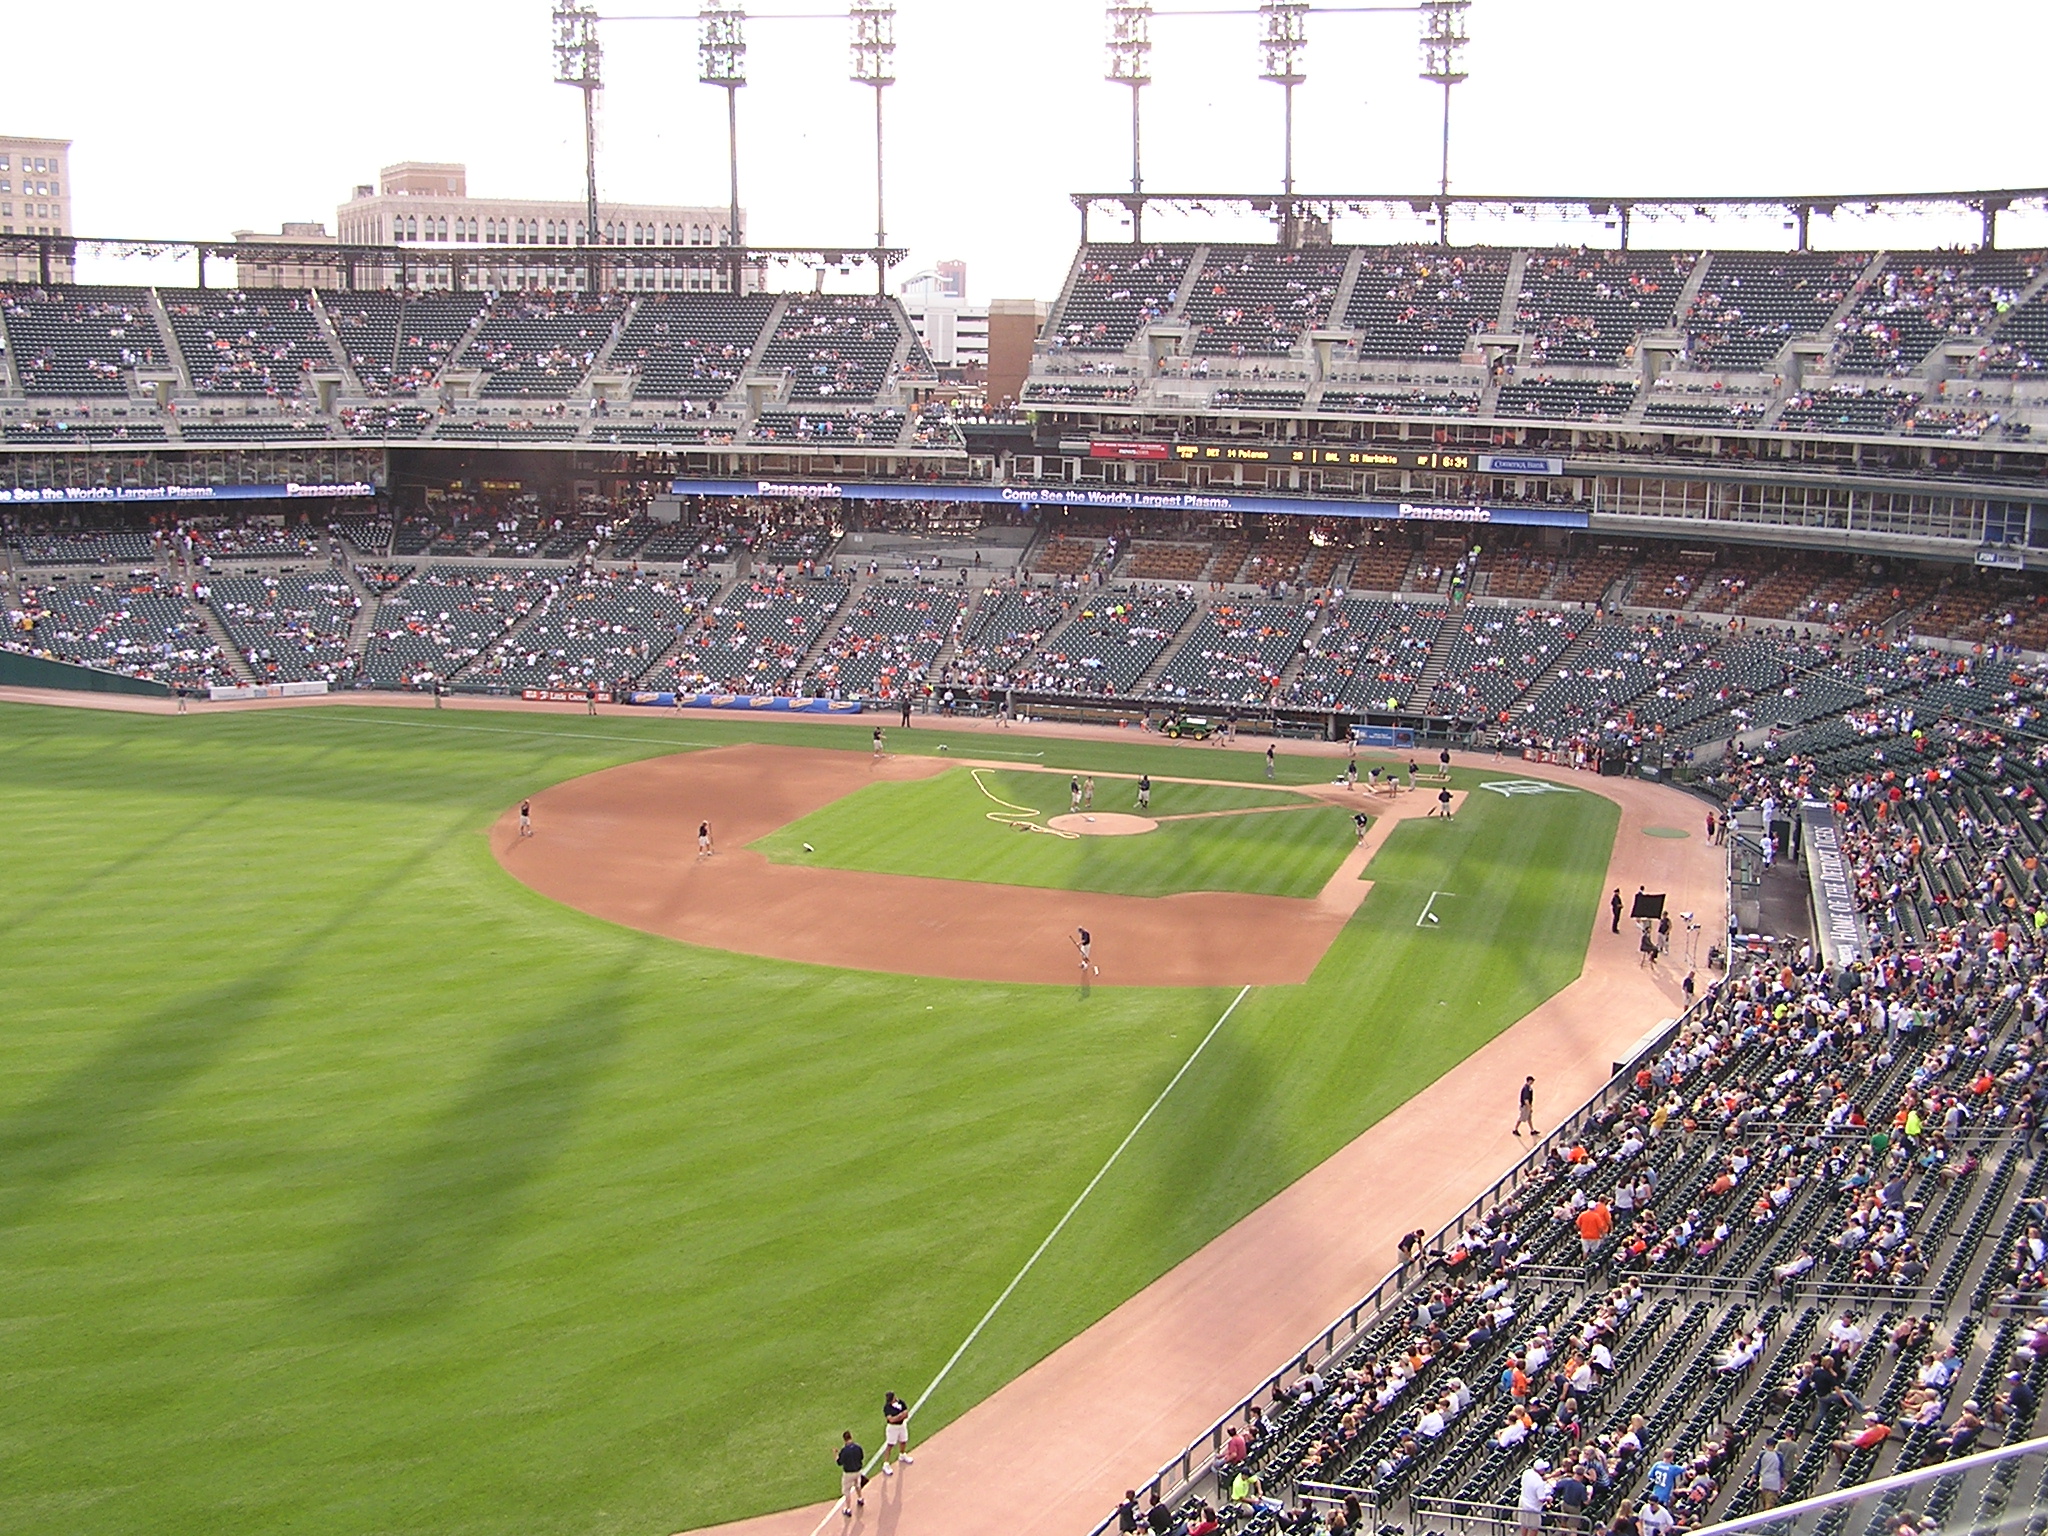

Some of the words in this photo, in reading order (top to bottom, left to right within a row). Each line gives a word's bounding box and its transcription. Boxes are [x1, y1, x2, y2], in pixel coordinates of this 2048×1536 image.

[1442, 455, 1468, 469] 6:34
[1527, 461, 1545, 470] Bank
[13, 488, 40, 500] See
[42, 487, 64, 499] the
[65, 487, 114, 499] World's
[117, 486, 166, 500] Largest
[167, 484, 217, 497] Plasma.
[286, 481, 371, 497] Panasonic
[757, 481, 842, 497] Panasonic
[1001, 487, 1038, 500] Come
[1040, 488, 1063, 501] See
[1065, 490, 1086, 502] the
[1087, 491, 1132, 505] World's
[1134, 492, 1182, 507] Largest
[1184, 494, 1232, 509] Plasma.
[1399, 503, 1491, 523] Panasonic
[549, 692, 567, 701] Little
[1814, 827, 1837, 849] TIGERS
[1818, 850, 1845, 881] DETROIT
[1824, 882, 1849, 899] THE
[1827, 899, 1851, 913] OF
[1830, 912, 1858, 942] HOME
